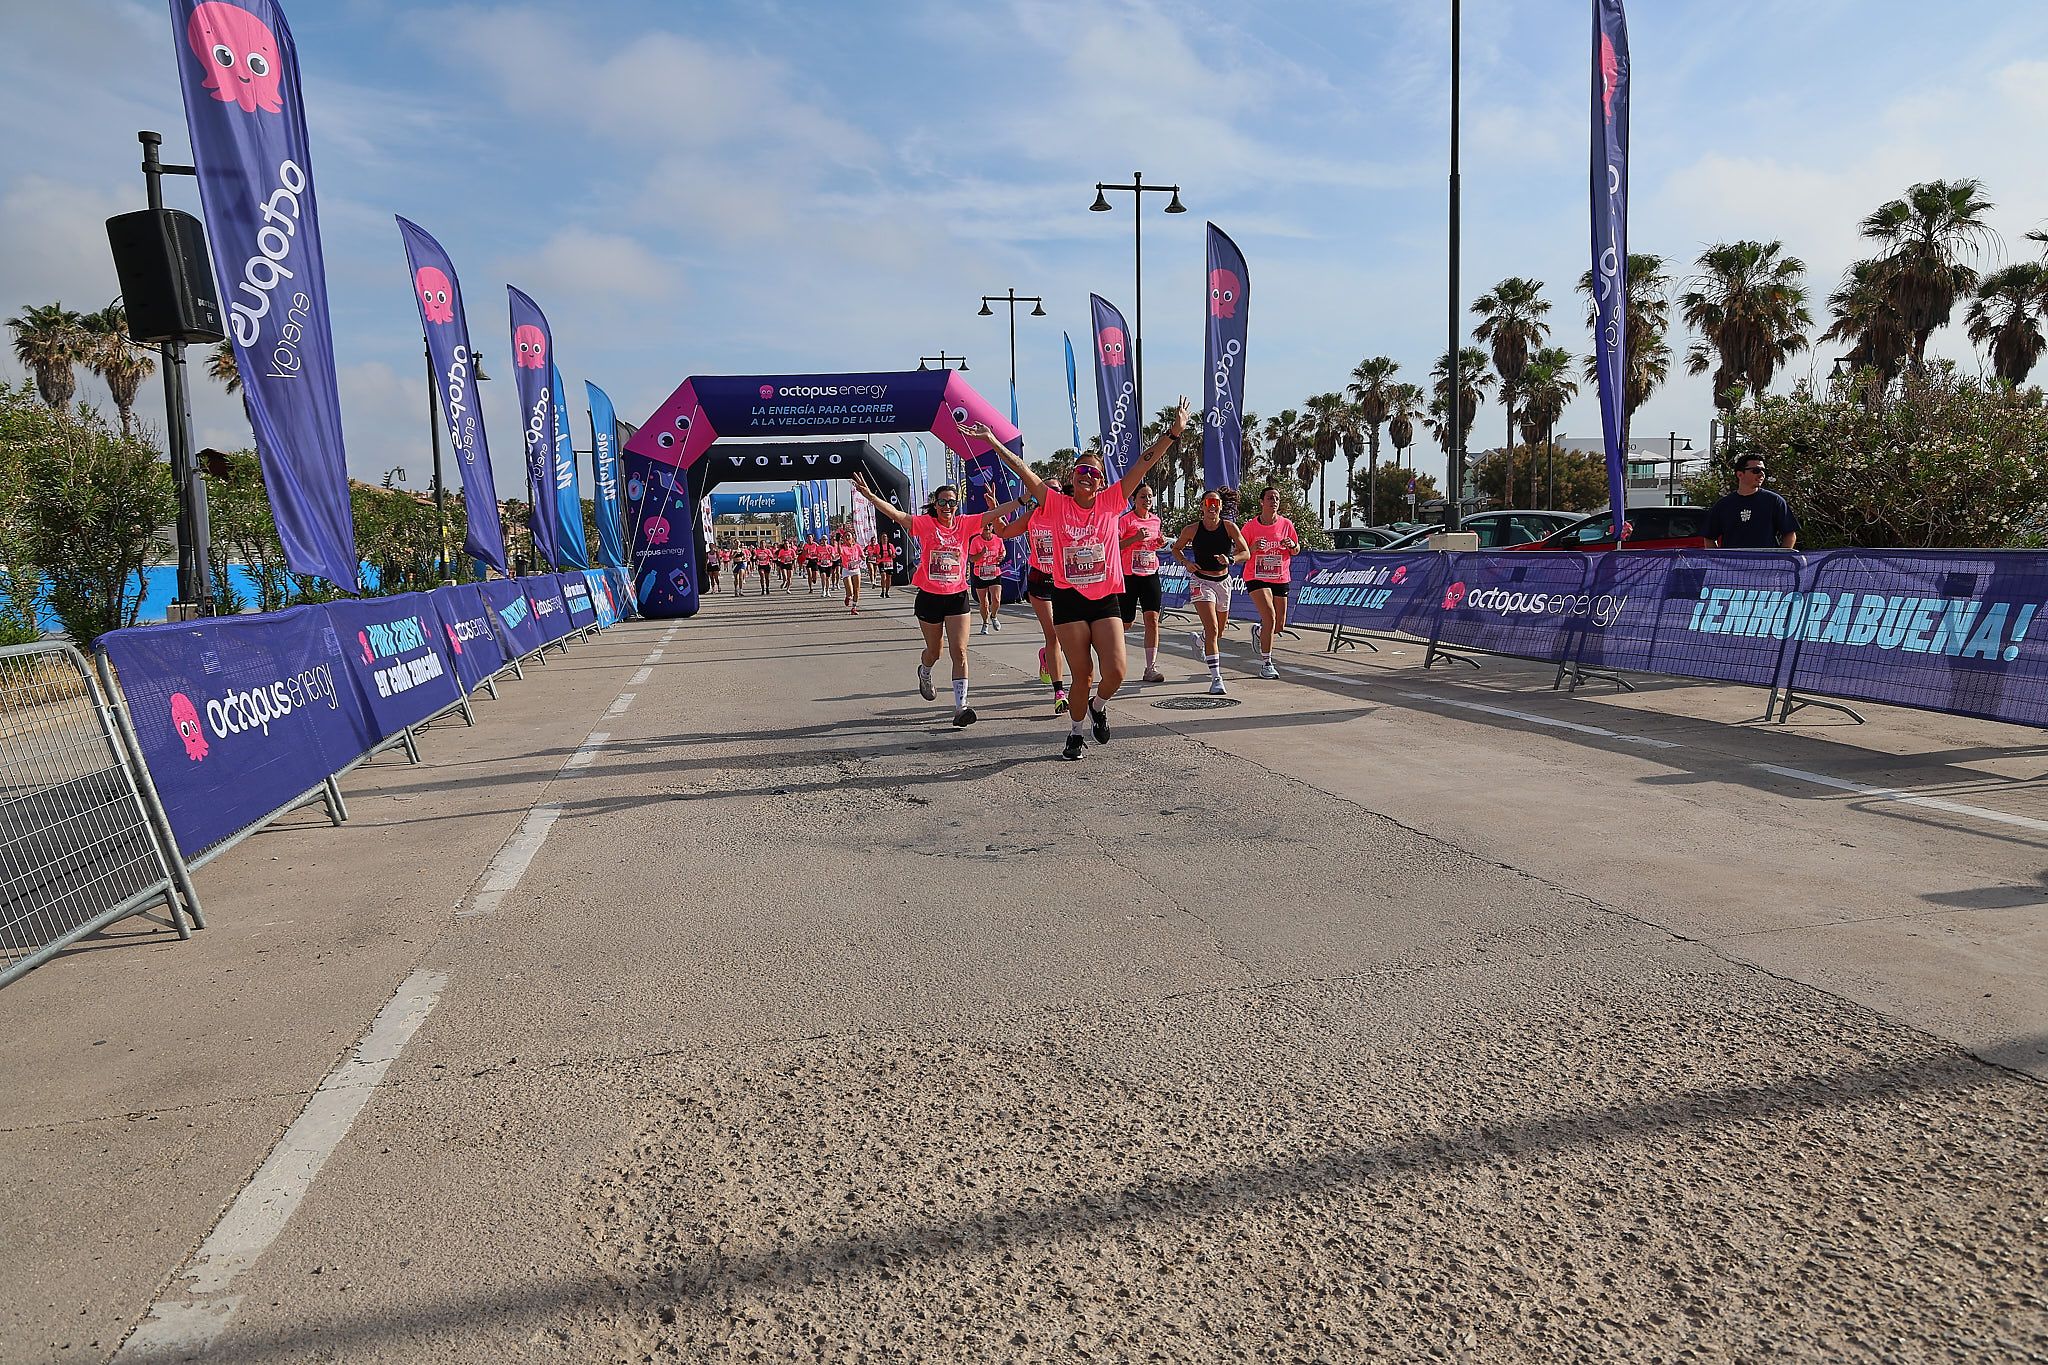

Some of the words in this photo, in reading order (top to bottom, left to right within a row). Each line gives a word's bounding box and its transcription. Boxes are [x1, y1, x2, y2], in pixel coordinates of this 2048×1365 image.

[779, 385, 838, 399] octopus
[838, 384, 888, 399] energy
[751, 406, 765, 415] LA
[768, 403, 816, 415] ENERGÍA
[818, 405, 847, 414] PARA
[850, 404, 894, 413] CORRER
[750, 418, 759, 426] A
[778, 417, 840, 425] VELOCIDAD
[842, 416, 856, 424] DE
[858, 416, 872, 424] LA
[875, 415, 896, 423] LUZ
[729, 453, 842, 466] VOLVO
[738, 494, 776, 511] Marlene
[890, 495, 904, 574] VOLO
[1334, 587, 1355, 606] DE
[1347, 587, 1369, 607] LA
[1362, 588, 1393, 610] LUZ
[1467, 587, 1548, 617] octopus
[1547, 592, 1628, 627] energy
[1687, 586, 2037, 663] ¡ENHORABUENA!
[206, 680, 293, 739] octopus
[287, 662, 340, 710] energy
